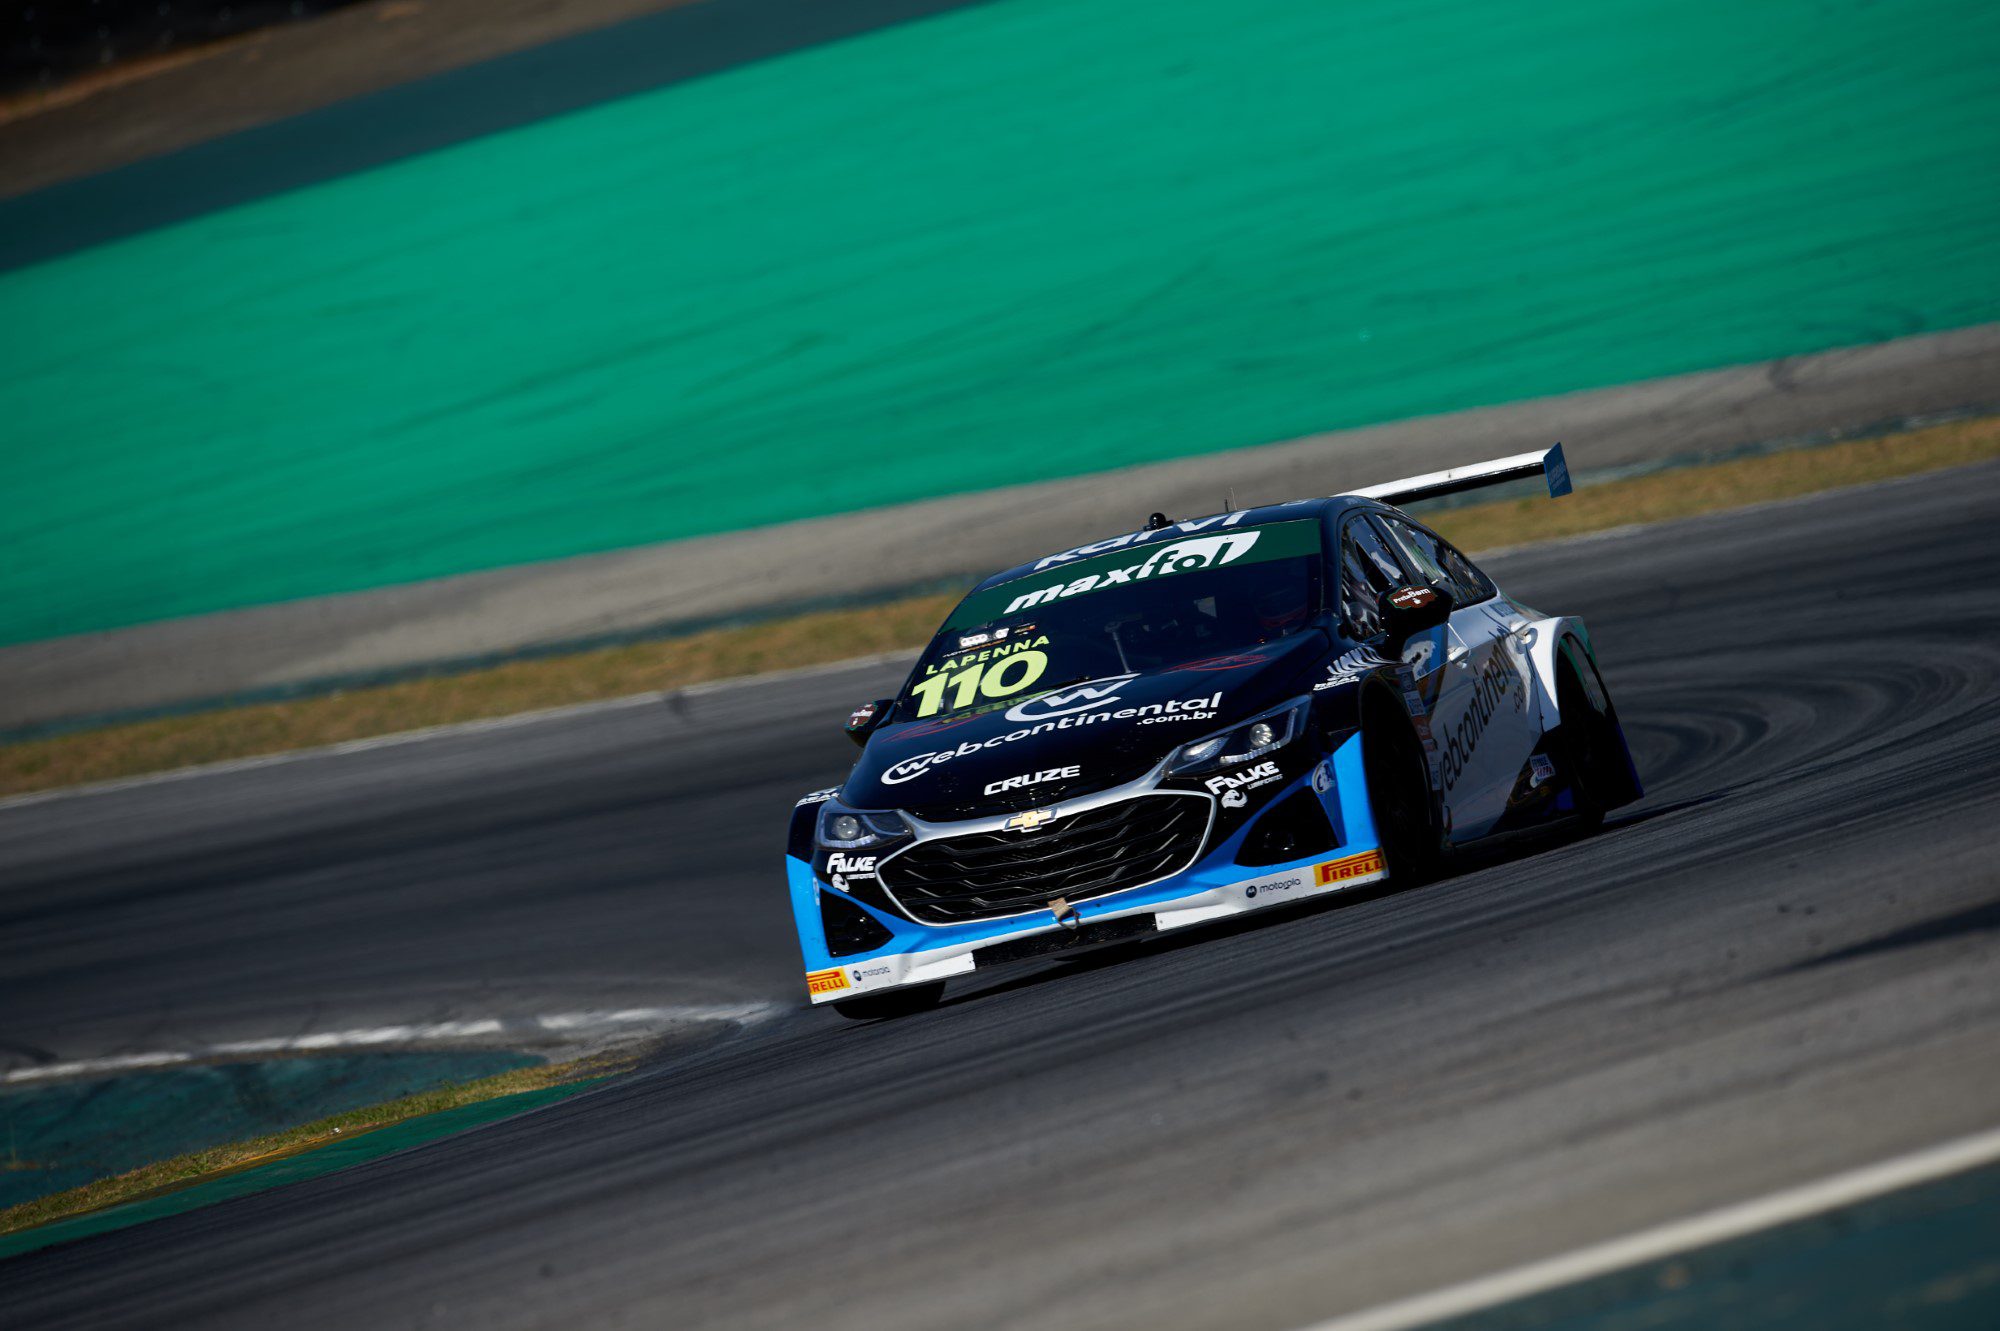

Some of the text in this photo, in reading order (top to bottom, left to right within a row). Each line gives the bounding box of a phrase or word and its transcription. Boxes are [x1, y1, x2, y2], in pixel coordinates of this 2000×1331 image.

[926, 635, 1050, 675] LAPENNA
[911, 650, 1048, 718] 110
[1136, 710, 1217, 726] .com.br
[984, 765, 1081, 796] CRUZE
[1205, 761, 1280, 795] FALKE
[827, 852, 878, 874] FALKE
[1259, 877, 1302, 893] motorola
